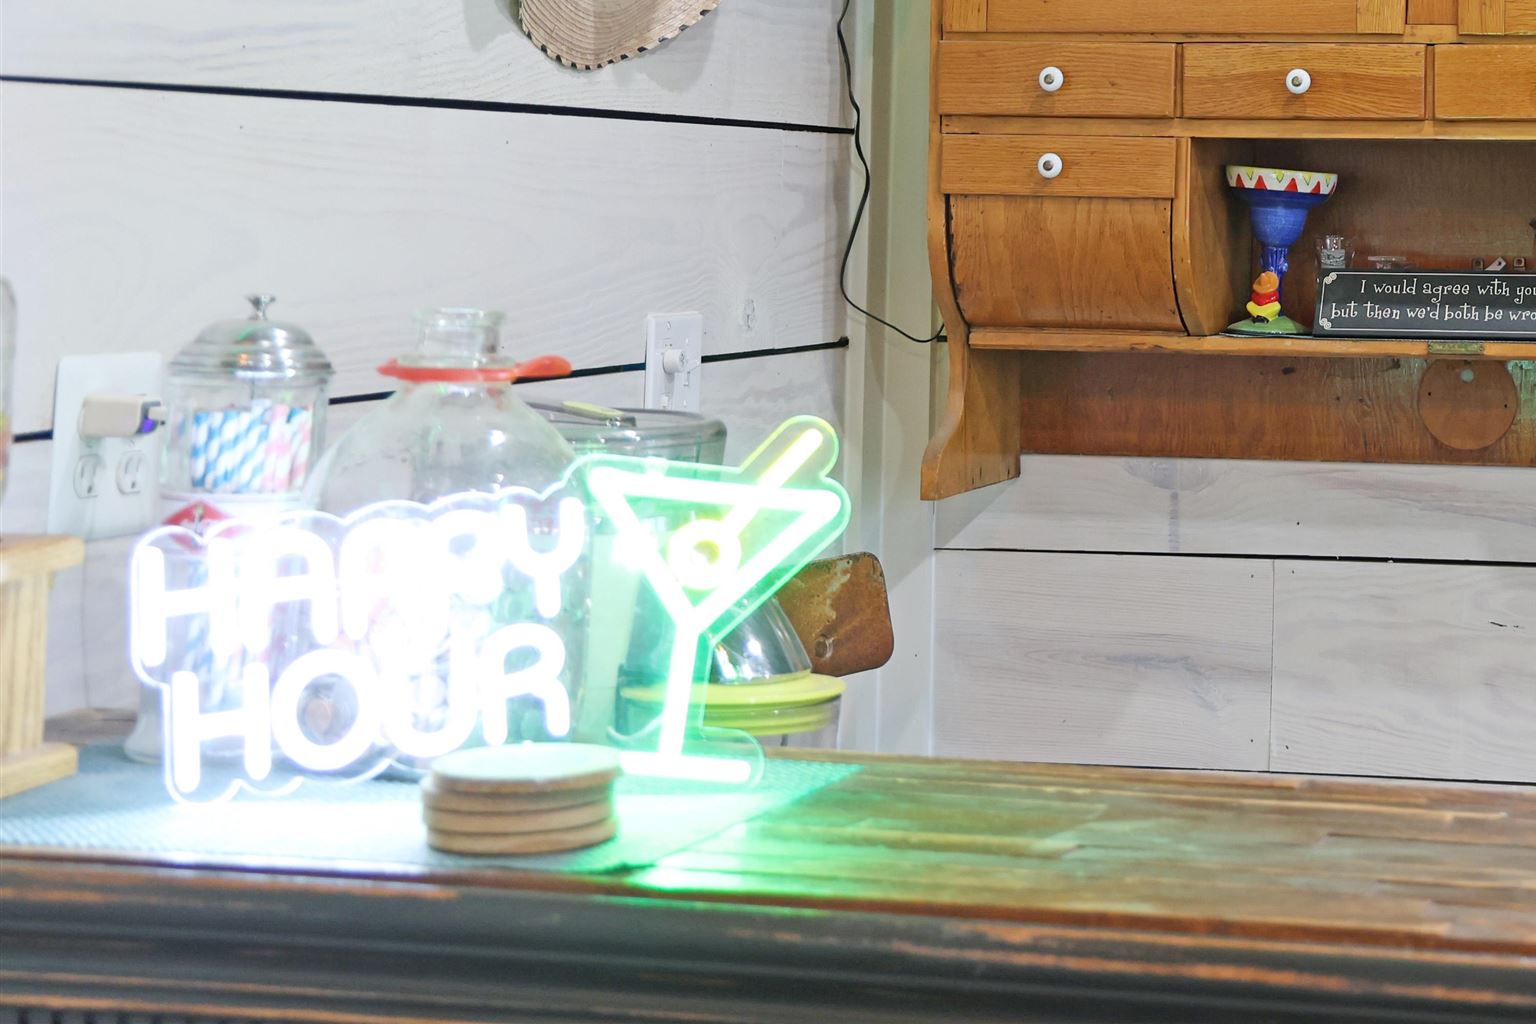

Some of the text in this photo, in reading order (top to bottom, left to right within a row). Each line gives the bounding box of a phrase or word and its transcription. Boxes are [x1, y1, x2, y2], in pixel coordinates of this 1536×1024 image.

[1331, 300, 1358, 319] but
[1363, 302, 1400, 319] then
[1406, 303, 1440, 320] we'd
[1444, 303, 1479, 321] both
[1484, 304, 1503, 321] be
[1360, 279, 1366, 294] I
[1374, 278, 1417, 295] would
[1422, 282, 1470, 303] agree
[1477, 278, 1510, 296] with
[136, 496, 585, 666] HAPPY
[171, 622, 571, 793] HOUR
